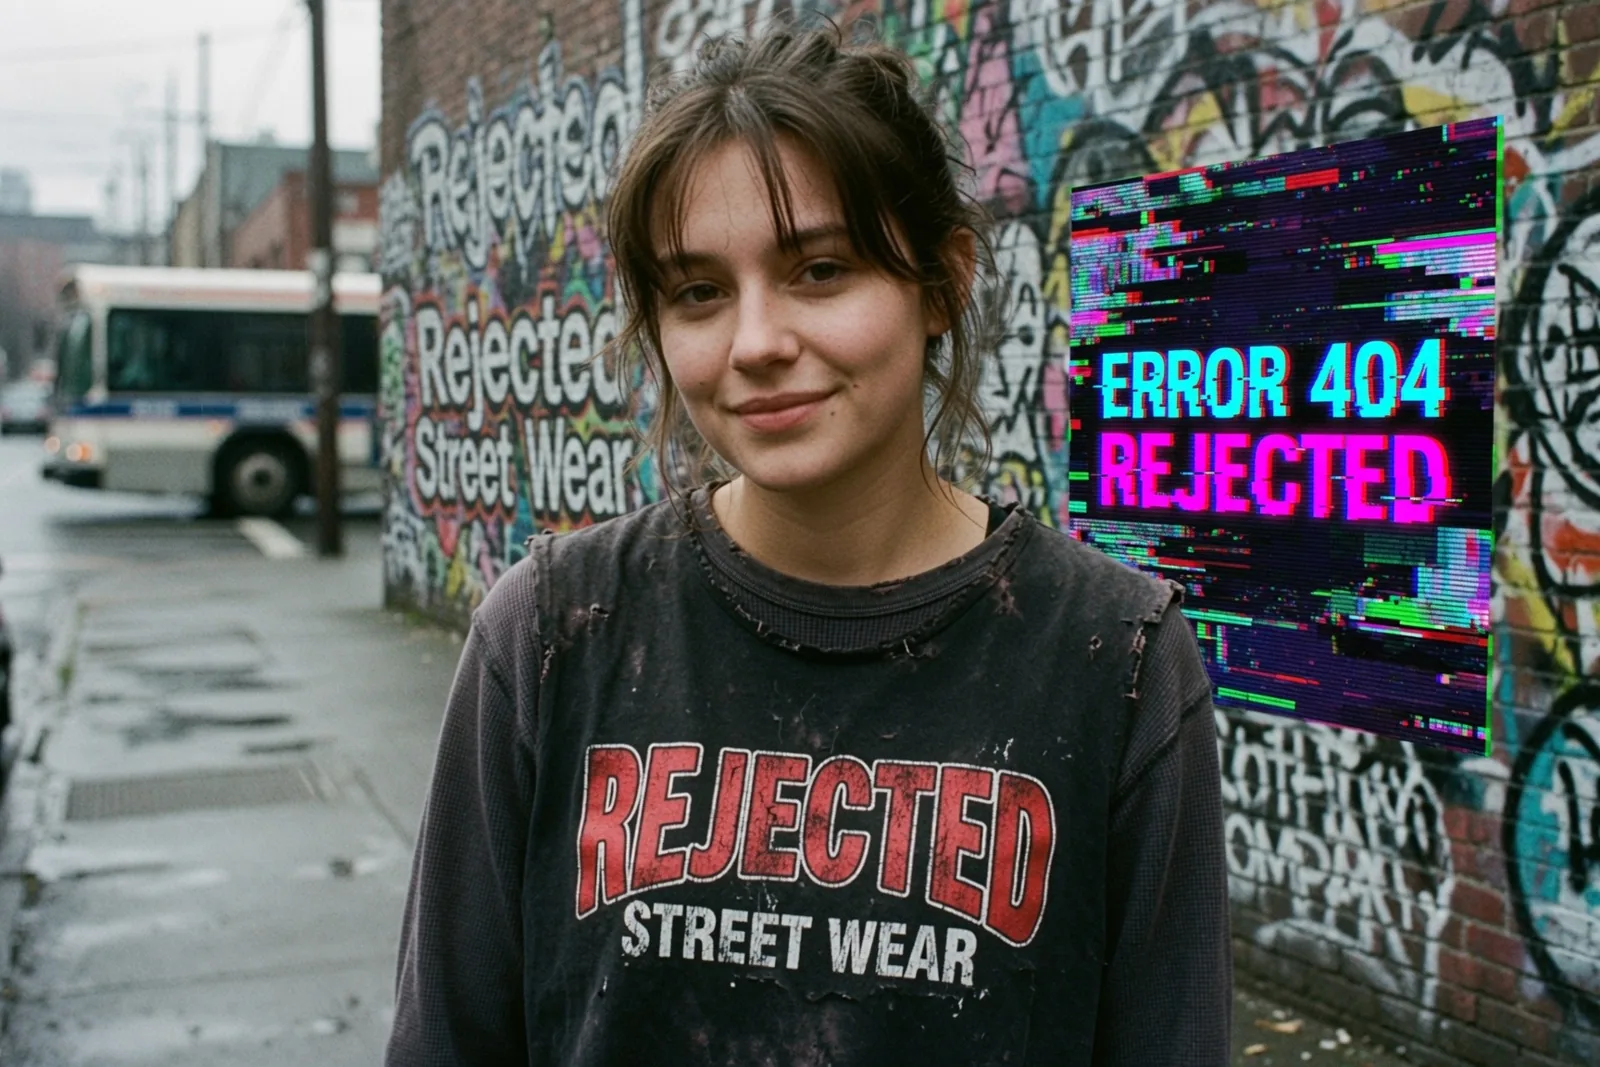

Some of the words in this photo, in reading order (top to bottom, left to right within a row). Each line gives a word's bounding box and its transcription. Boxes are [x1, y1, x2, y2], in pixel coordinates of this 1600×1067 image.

[410, 0, 645, 271] Rejected
[416, 280, 628, 431] Rejected
[1101, 344, 1290, 419] ERROR
[1309, 338, 1451, 418] 404
[416, 417, 516, 508] Street
[525, 416, 634, 515] Wear
[1099, 431, 1453, 523] REJECTED
[576, 742, 1056, 947] REJECTED
[620, 900, 813, 970] STREET
[828, 916, 979, 987] WEAR
[1225, 812, 1456, 1012] OMPANY
